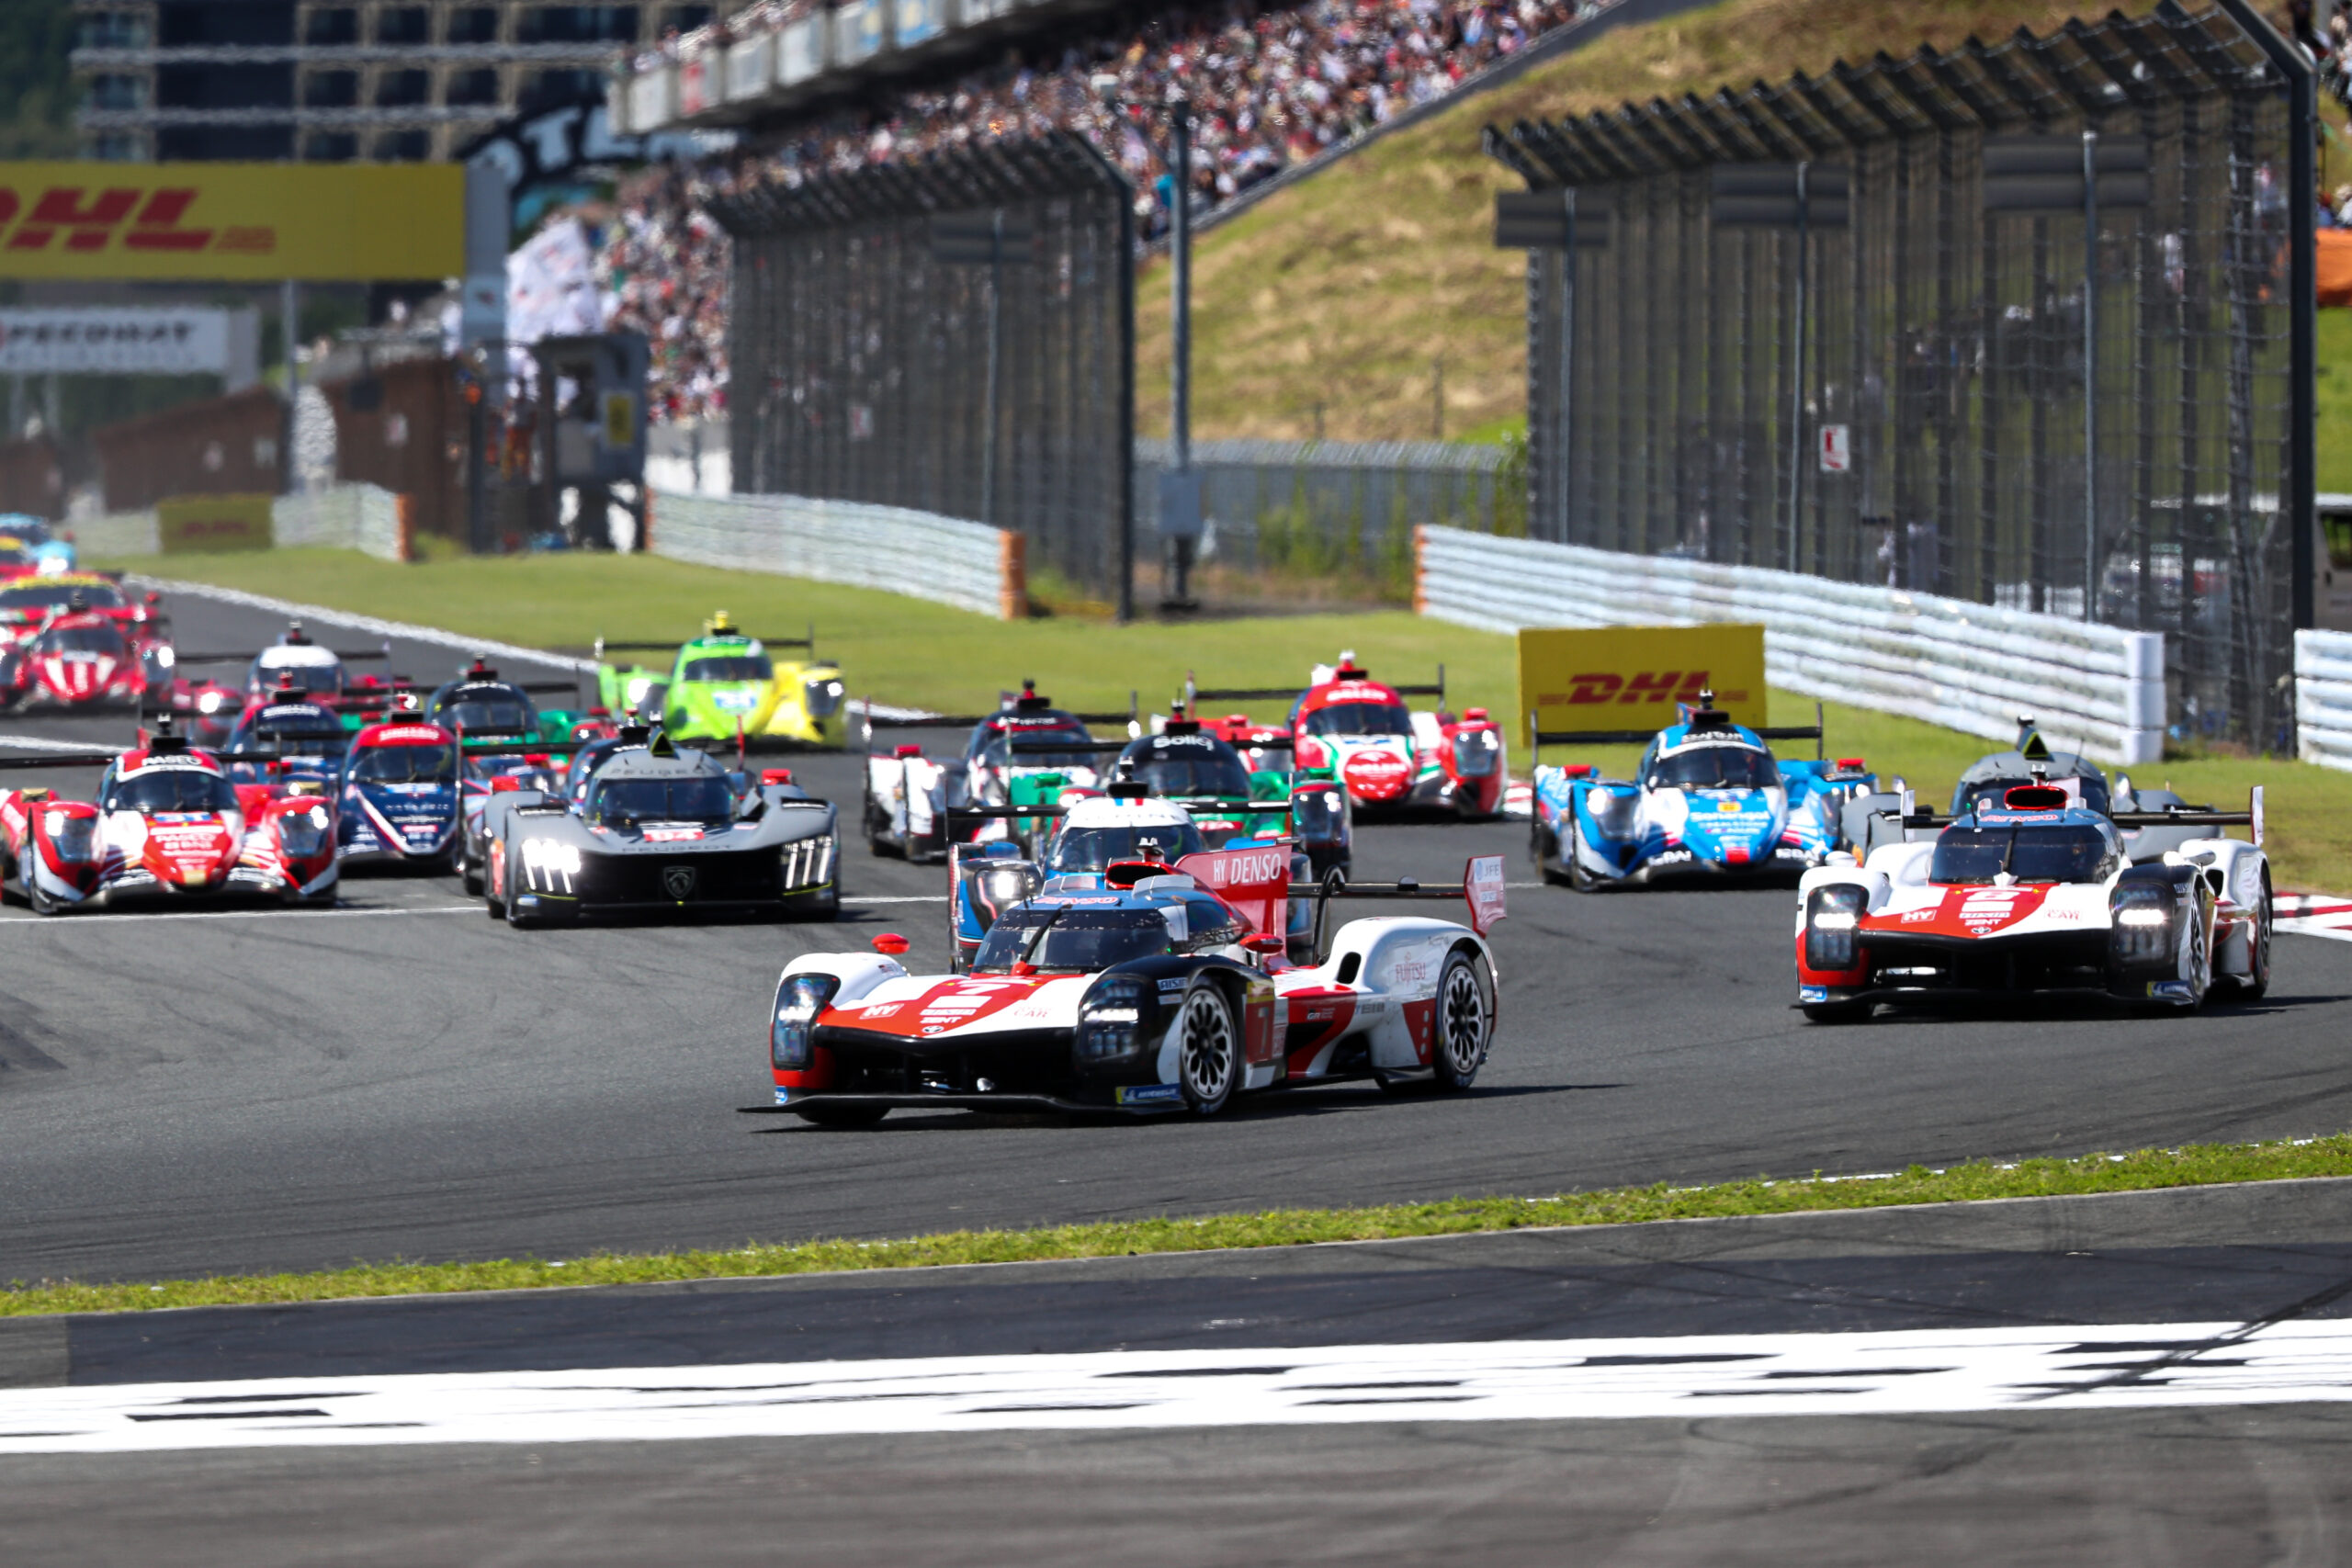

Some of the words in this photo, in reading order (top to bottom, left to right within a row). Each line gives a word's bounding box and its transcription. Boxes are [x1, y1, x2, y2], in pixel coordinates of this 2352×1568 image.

[1567, 671, 1717, 705] DHL
[1213, 859, 1226, 882] HY
[1230, 853, 1281, 885] DENSO
[1485, 864, 1499, 876] JFE
[1905, 910, 1933, 921] HY
[1396, 963, 1426, 985] FUJITSU
[956, 983, 1011, 995] 7
[866, 1005, 895, 1017] HY
